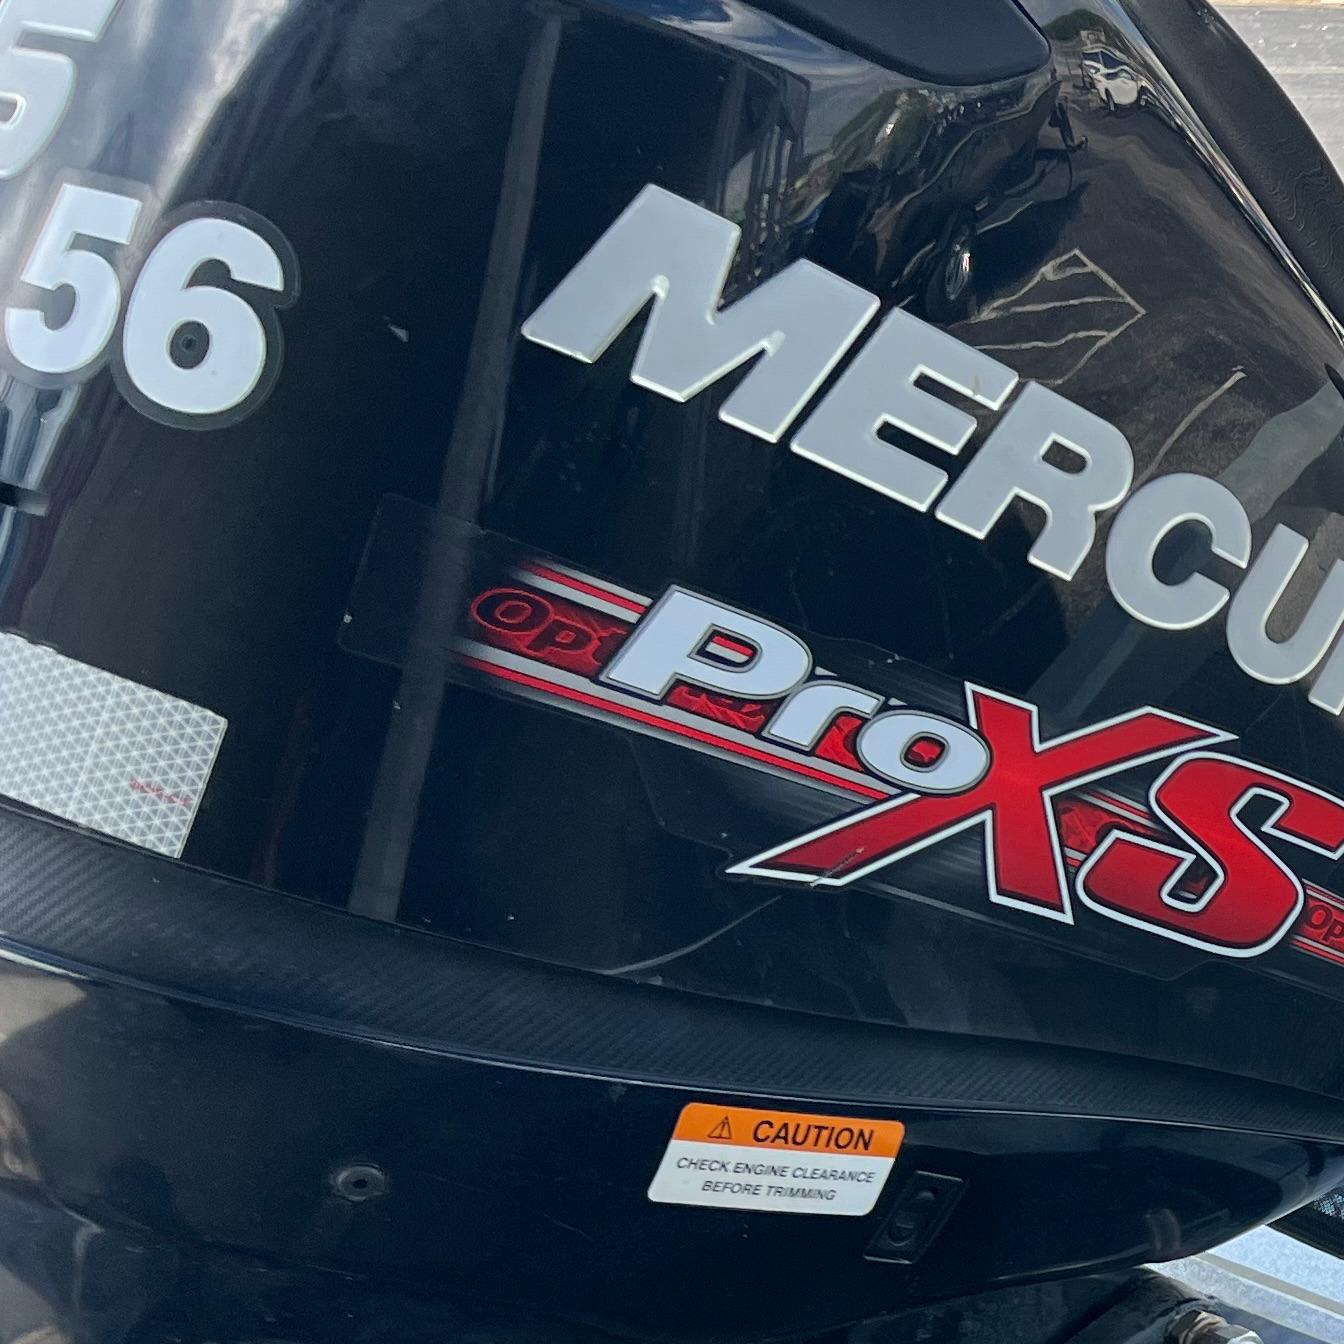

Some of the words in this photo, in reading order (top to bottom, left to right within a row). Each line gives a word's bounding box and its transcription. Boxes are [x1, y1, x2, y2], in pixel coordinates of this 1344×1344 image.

[5, 183, 285, 415] 56
[752, 1119, 875, 1151] CAUTION
[676, 1156, 731, 1174] CHECK
[733, 1161, 789, 1178] ENGINE
[791, 1166, 877, 1184] CLEARANCE
[701, 1180, 761, 1196] BEFORE
[764, 1185, 838, 1201] TRIMMING
